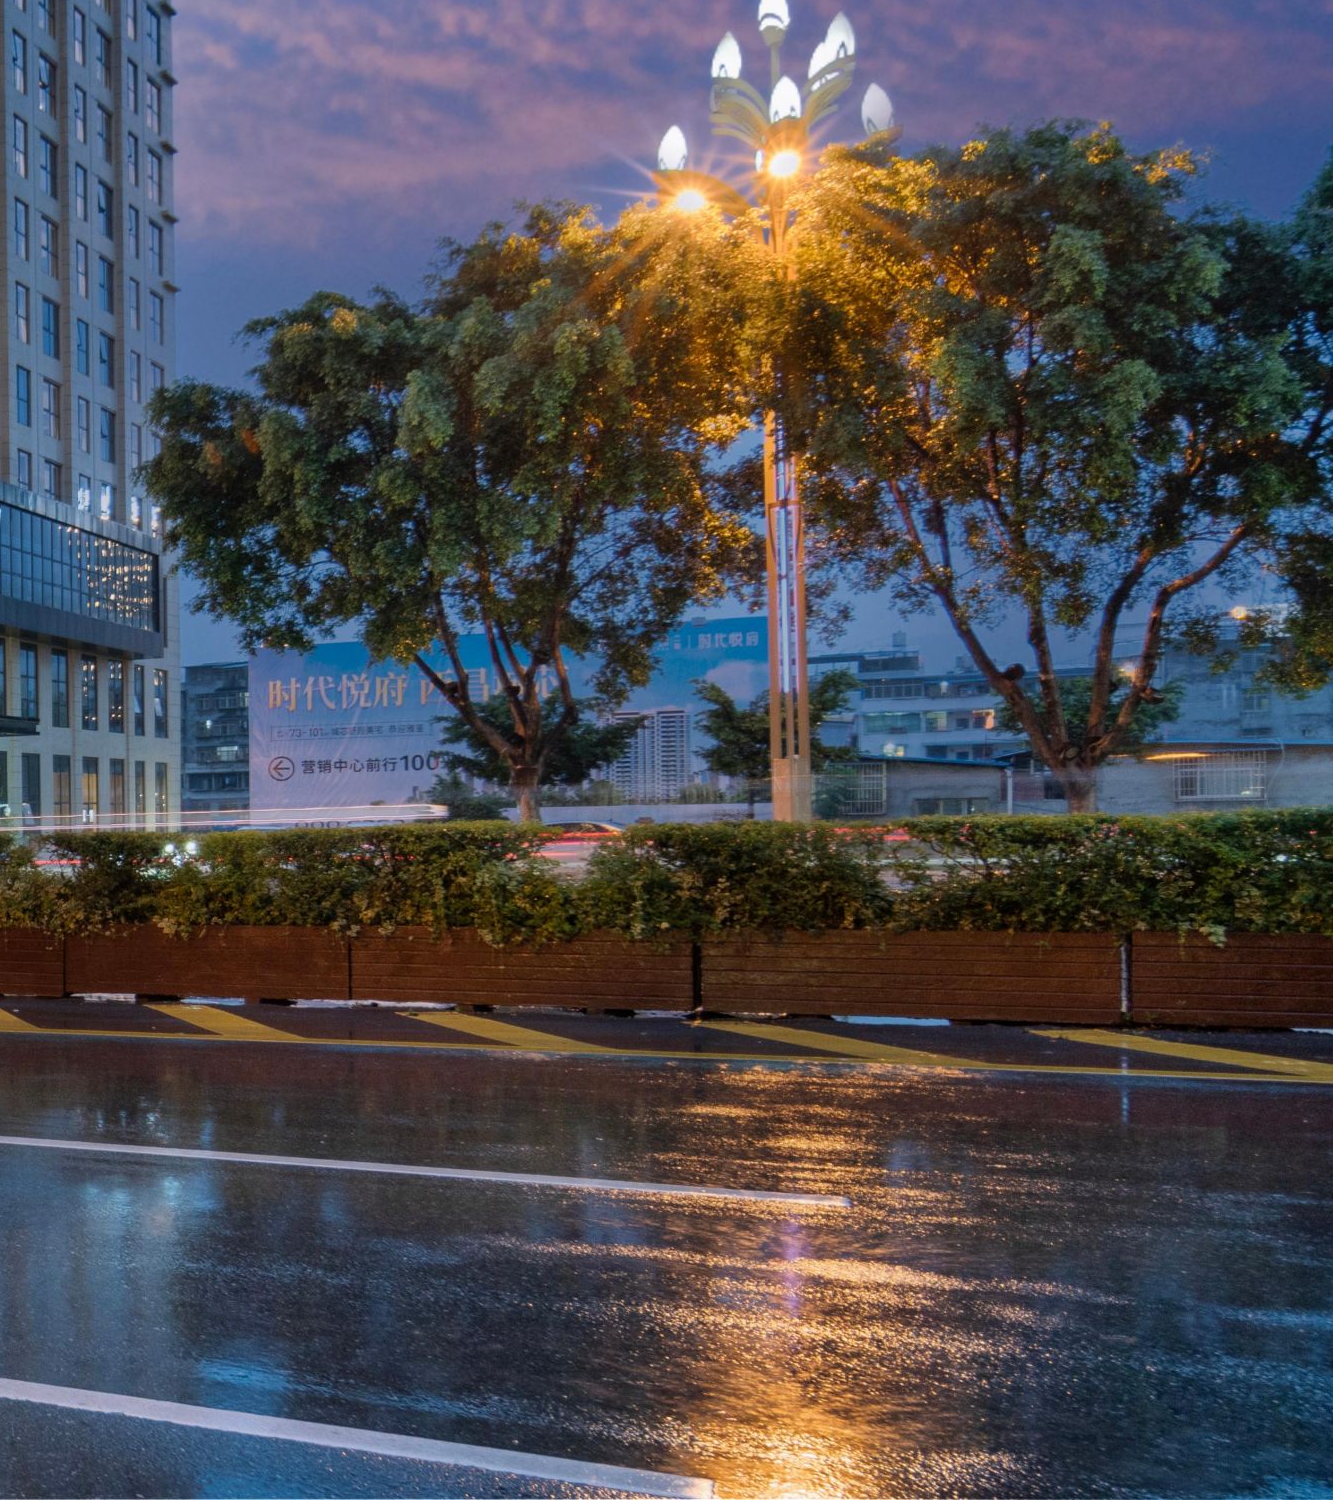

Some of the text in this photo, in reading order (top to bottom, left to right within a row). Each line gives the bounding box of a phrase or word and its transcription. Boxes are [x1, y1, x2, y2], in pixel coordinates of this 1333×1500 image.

[268, 672, 408, 713] 时代悦府
[301, 754, 445, 775] 营销中心前行100
